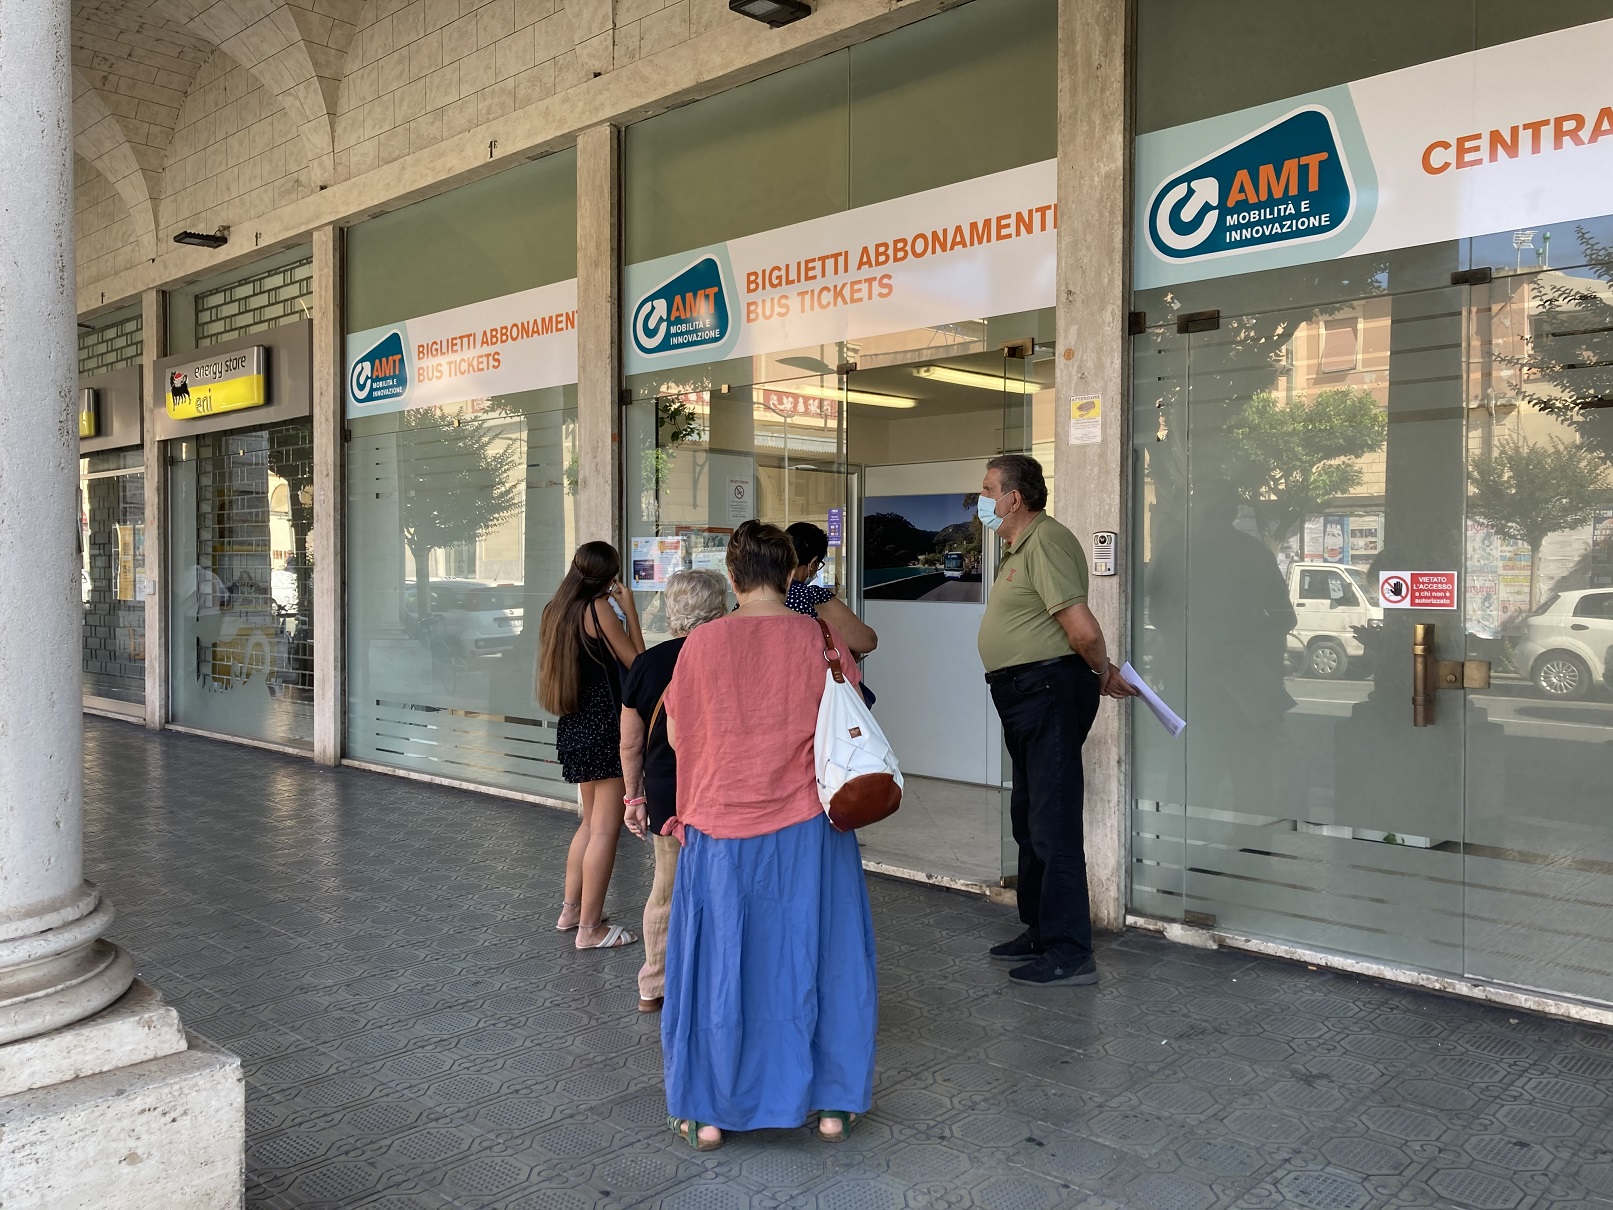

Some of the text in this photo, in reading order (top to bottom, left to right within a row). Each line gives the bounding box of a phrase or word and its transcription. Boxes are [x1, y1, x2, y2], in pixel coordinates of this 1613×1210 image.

[1421, 106, 1613, 176] CENTRA
[1225, 151, 1329, 208] AMT
[1225, 200, 1311, 227] MOBILITÀ E
[1225, 213, 1331, 243] INNOVAZIONE
[746, 250, 849, 294] BIGLIETTI
[670, 286, 719, 321] AMT
[745, 273, 894, 324] BUS TICKETS
[417, 309, 578, 361] BIGLIETTI ABBONAMEN
[670, 319, 711, 335] MOBILITÀ E
[670, 329, 720, 345] INNOVAZIONE
[194, 355, 247, 380] energy store
[372, 354, 402, 378] AMT
[417, 351, 501, 383] BUS TICKETS
[372, 379, 393, 388] MOBILITÀ
[372, 386, 403, 397] INNOVAZIONE
[196, 388, 213, 414] eni
